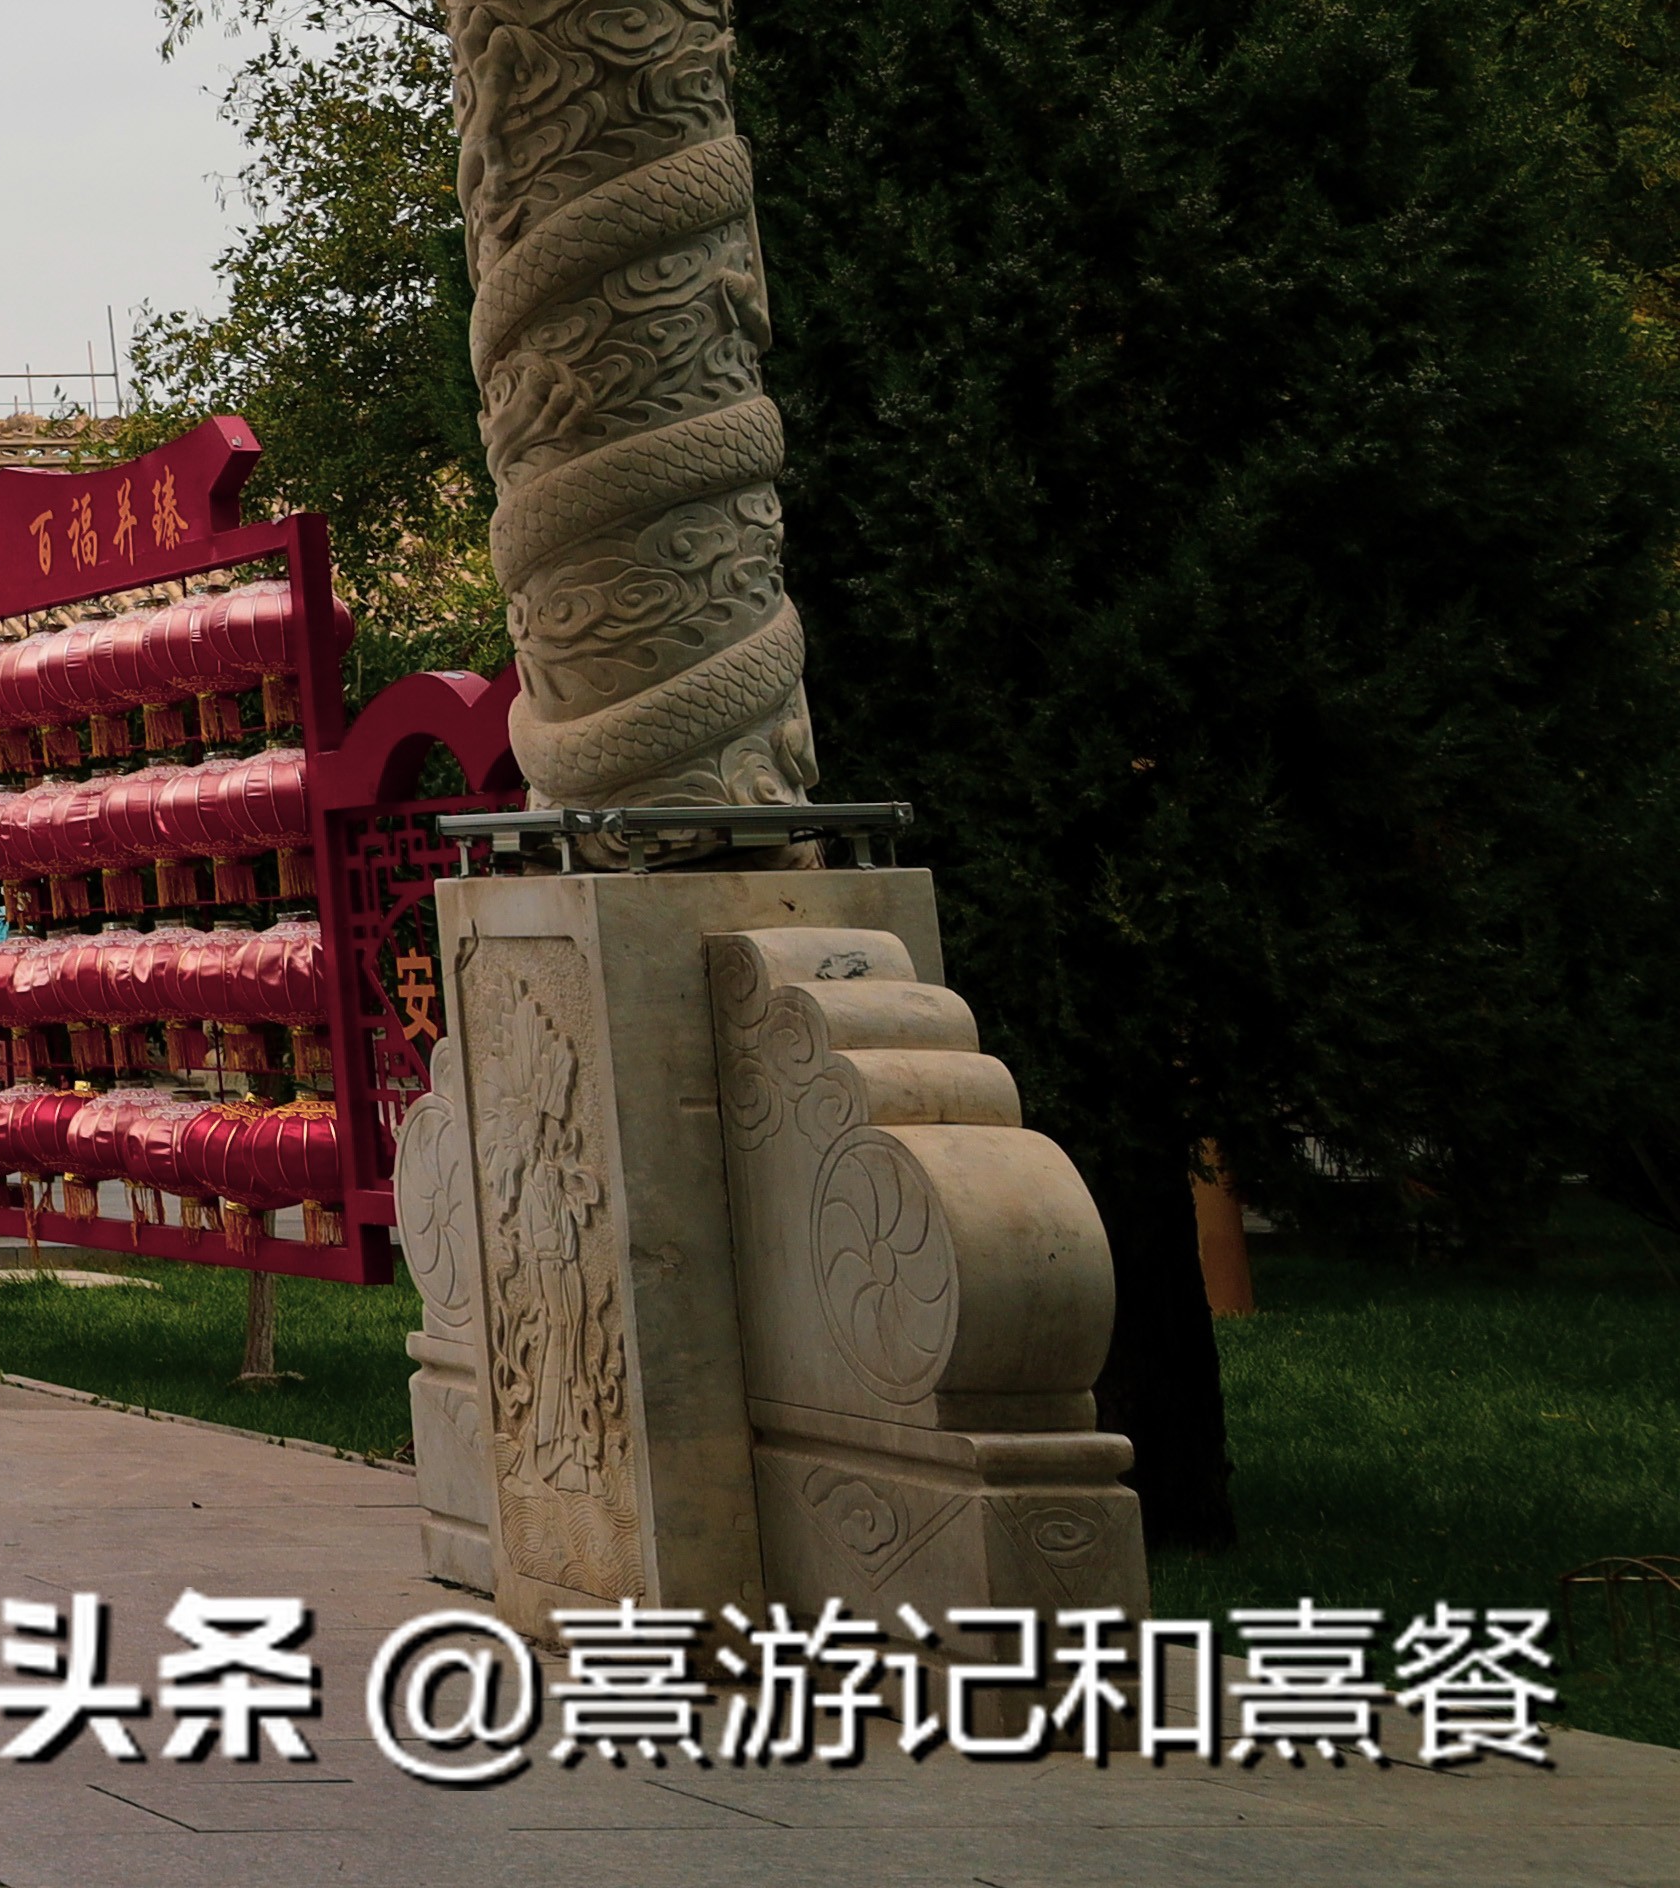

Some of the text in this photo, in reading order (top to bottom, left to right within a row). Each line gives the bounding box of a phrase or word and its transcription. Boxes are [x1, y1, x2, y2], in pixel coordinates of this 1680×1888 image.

[29, 465, 189, 576] 百福并臻
[395, 946, 438, 1041] 安
